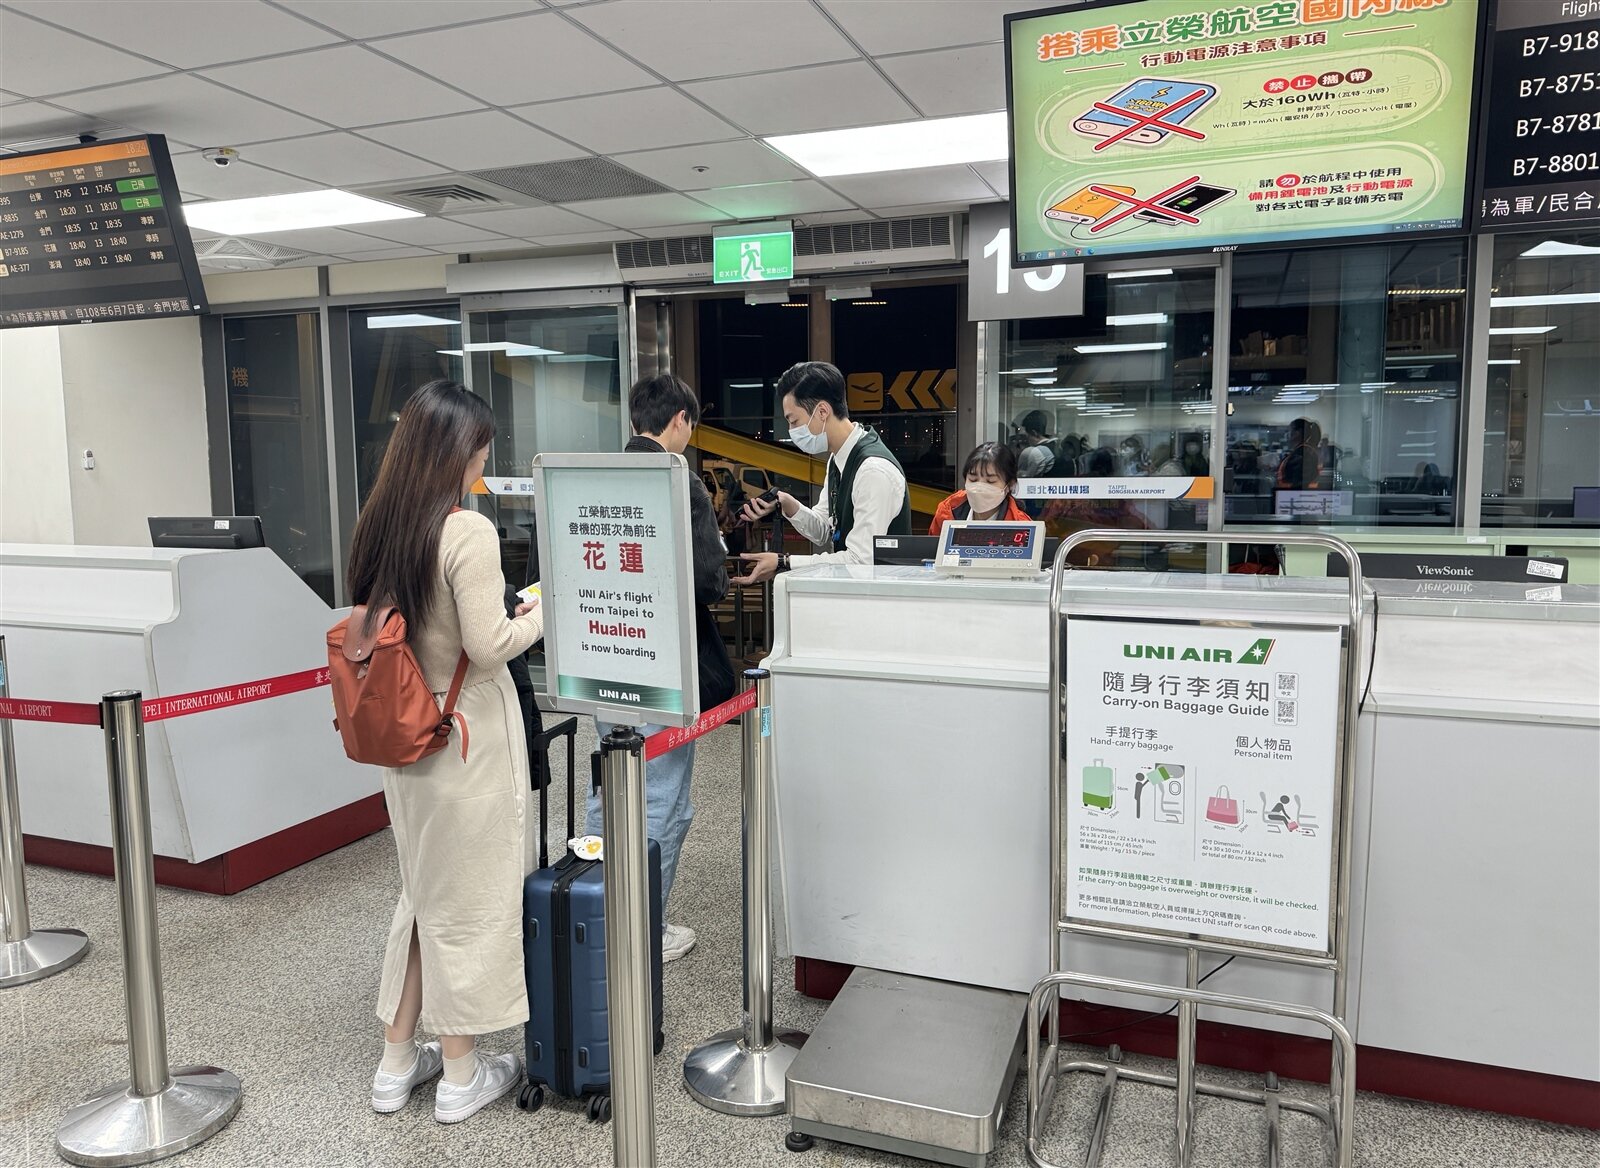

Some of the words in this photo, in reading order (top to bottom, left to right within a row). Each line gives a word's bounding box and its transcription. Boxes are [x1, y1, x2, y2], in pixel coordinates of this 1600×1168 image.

[1140, 31, 1327, 68] 行動電源注意事項
[1267, 70, 1368, 93] 禁止攜帶
[1242, 91, 1336, 110] 大於160Wh
[1297, 104, 1330, 113] 計算方式
[1516, 111, 1600, 137] B7-8781
[1512, 151, 1600, 177] B7-8801
[1259, 167, 1402, 189] 請勿於航程中使用
[54, 188, 72, 199] 17:45
[80, 186, 89, 196] 12
[95, 183, 113, 194] 17:45
[34, 209, 48, 219] 金門
[59, 206, 77, 216] 18:20
[85, 204, 94, 213] 11
[100, 201, 118, 212] 18:10
[1255, 191, 1404, 213] 對各式電子設備充電
[0, 229, 24, 240] AE-1279
[39, 226, 53, 236] 金門
[64, 223, 82, 233] 18:35
[90, 221, 99, 231] 12
[104, 218, 123, 229] 18:35
[69, 240, 87, 250] 18:40
[94, 238, 103, 248] 13
[109, 236, 128, 246] 18:40
[1212, 245, 1239, 253] SUNRAY
[10, 263, 30, 273] AE-377
[73, 257, 91, 267] 18:40
[99, 256, 108, 265] 12
[114, 253, 132, 264] 18:40
[766, 265, 788, 275] 緊急出口
[719, 269, 739, 278] EXIT
[231, 366, 249, 388] 機
[578, 505, 644, 520] 立榮航空現在
[568, 522, 657, 538] 登機的班次為前往
[1013, 533, 1023, 543] 0
[1416, 565, 1474, 577] ViewSonic
[578, 588, 596, 599] UNI
[598, 589, 622, 602] Air's
[624, 592, 653, 604] flight
[579, 603, 604, 614] from
[607, 605, 639, 618] Taipei
[642, 608, 654, 619] to
[588, 620, 647, 639] Hualien
[581, 641, 589, 651] is
[591, 645, 611, 654] now
[613, 644, 656, 661] boarding
[1123, 644, 1175, 660] UNI
[1180, 647, 1233, 664] AIR
[1102, 671, 1270, 702] 隨身行李須知
[142, 704, 162, 718] PEI
[166, 691, 235, 714] INTERNATIONAL
[237, 682, 272, 699] AIRPORT
[598, 688, 620, 700] UNI
[619, 691, 641, 702] AIR
[739, 692, 757, 709] INTER
[19, 703, 52, 717] AIRPORT
[1102, 695, 1160, 710] Carry-on
[1163, 699, 1224, 715] Baggage
[1228, 703, 1270, 717] Guide
[1105, 726, 1158, 740] 手提行李
[1090, 737, 1136, 749] Hand-carry
[1137, 740, 1174, 752] baggage
[1235, 736, 1292, 752] 個人物品
[1234, 749, 1271, 760] Personal
[1272, 751, 1293, 761] item
[1090, 826, 1117, 834] Dimension
[1213, 840, 1242, 848] Dimension
[1085, 875, 1097, 883] the
[1097, 878, 1128, 887] carry-on
[1128, 881, 1160, 892] baggage
[1167, 886, 1209, 898] overweight
[1219, 893, 1252, 903] oversize,
[1253, 895, 1259, 904] it
[1260, 897, 1273, 905] will
[1274, 898, 1284, 906] be
[1285, 901, 1319, 911] checked.
[1109, 904, 1151, 918] information,
[1151, 911, 1174, 920] please
[1174, 914, 1201, 924] contact
[1202, 917, 1216, 925] UNI
[1217, 920, 1233, 928] staff
[1243, 923, 1260, 931] scan
[1261, 925, 1273, 933] QR
[1273, 927, 1292, 936] code
[1293, 929, 1318, 939] above.
